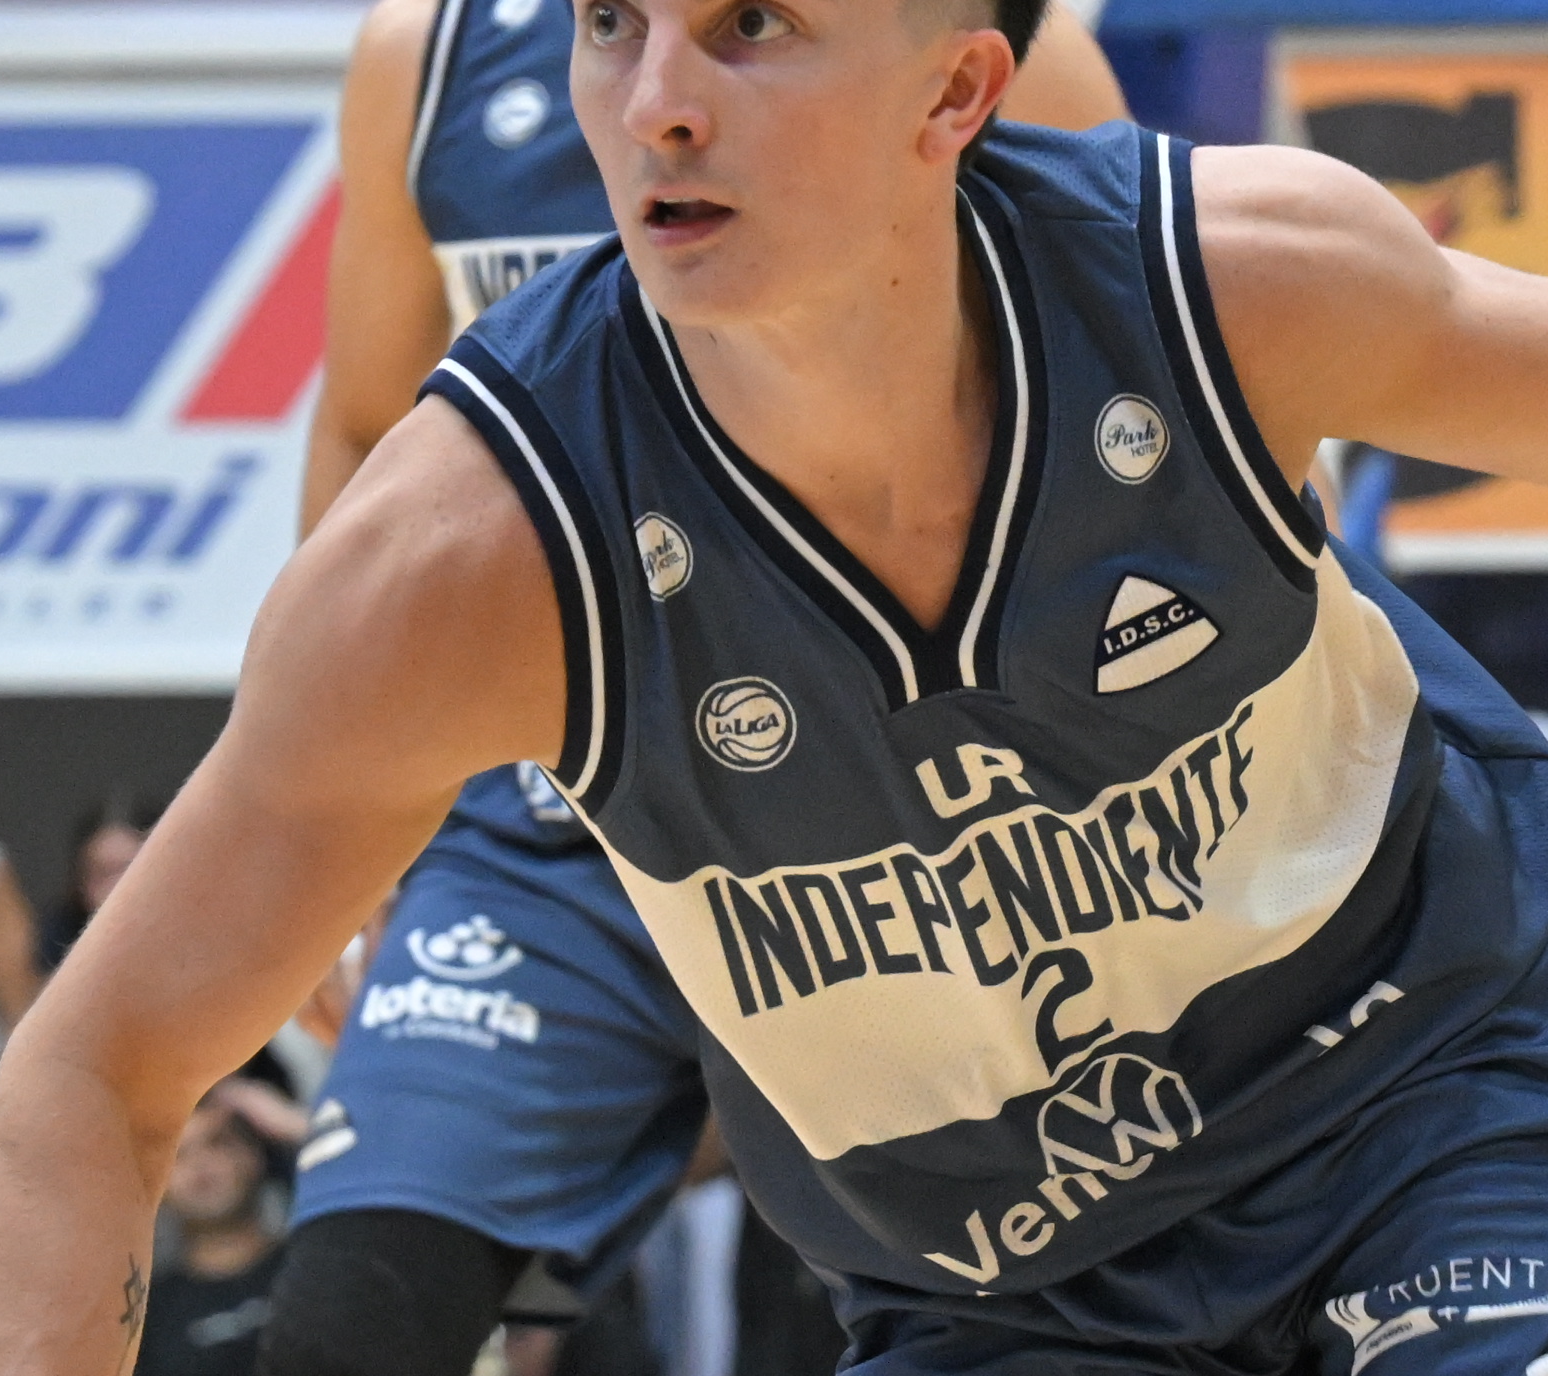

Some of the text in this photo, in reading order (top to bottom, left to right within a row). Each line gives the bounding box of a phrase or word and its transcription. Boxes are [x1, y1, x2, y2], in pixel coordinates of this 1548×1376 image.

[1104, 419, 1159, 450] Park
[1131, 441, 1160, 459] HOTEL
[1103, 602, 1195, 655] I.D.S.C.
[1021, 947, 1114, 1078] 2
